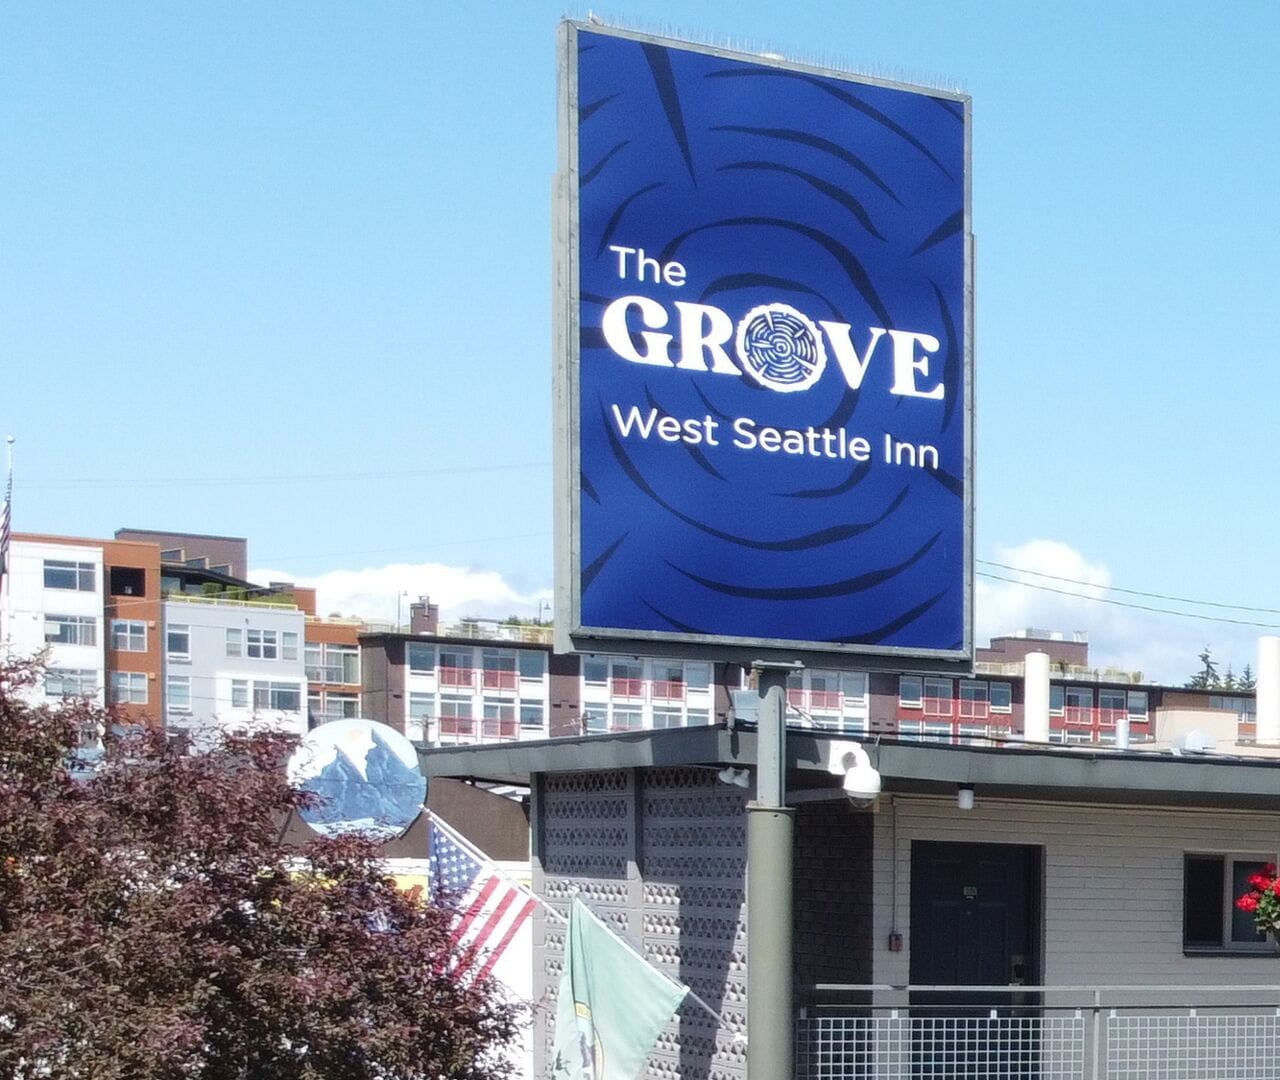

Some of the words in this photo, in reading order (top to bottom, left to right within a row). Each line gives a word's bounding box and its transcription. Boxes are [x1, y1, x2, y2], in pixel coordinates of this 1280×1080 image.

[609, 245, 687, 287] The
[601, 295, 945, 401] GROVE
[611, 404, 719, 446] West
[733, 415, 871, 462] Seattle
[885, 433, 939, 470] Inn
